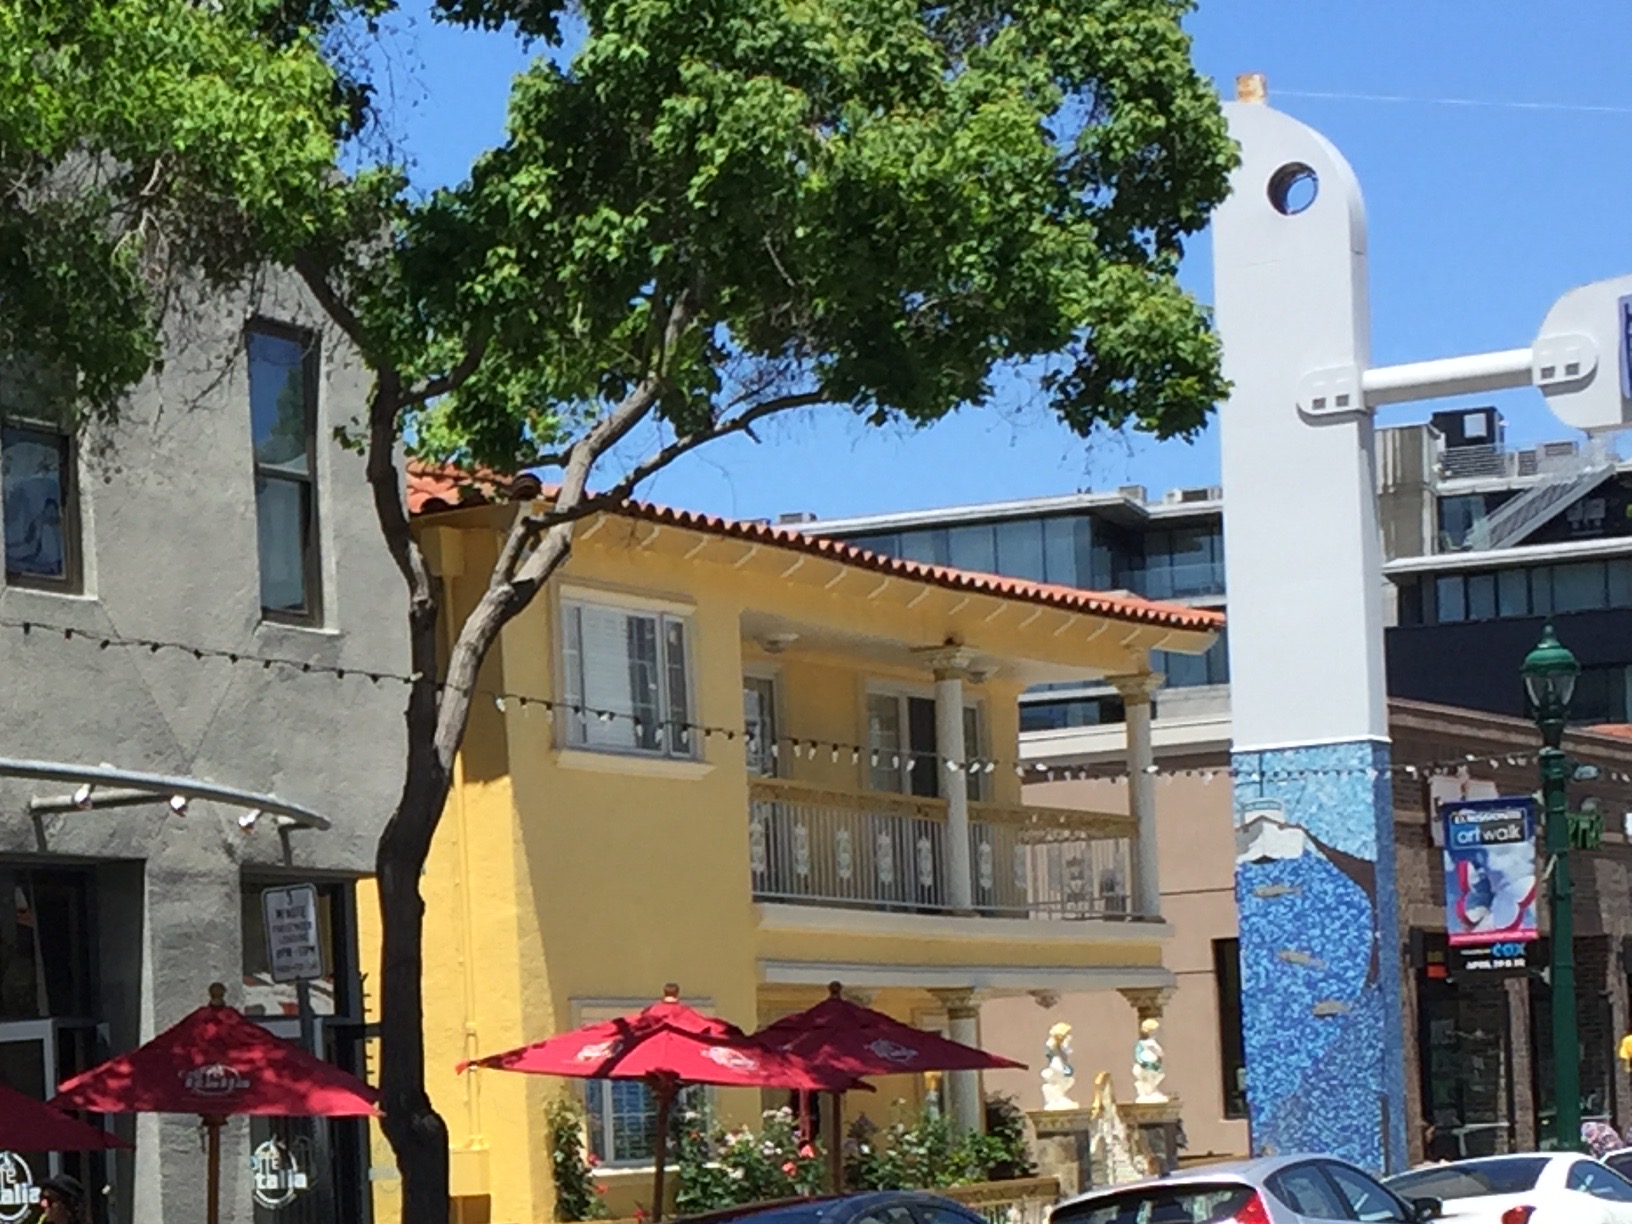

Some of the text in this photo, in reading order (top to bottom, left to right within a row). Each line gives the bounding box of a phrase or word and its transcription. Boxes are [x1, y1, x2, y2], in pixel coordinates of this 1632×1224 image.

[1457, 824, 1521, 844] art walk
[254, 1167, 307, 1190] talia
